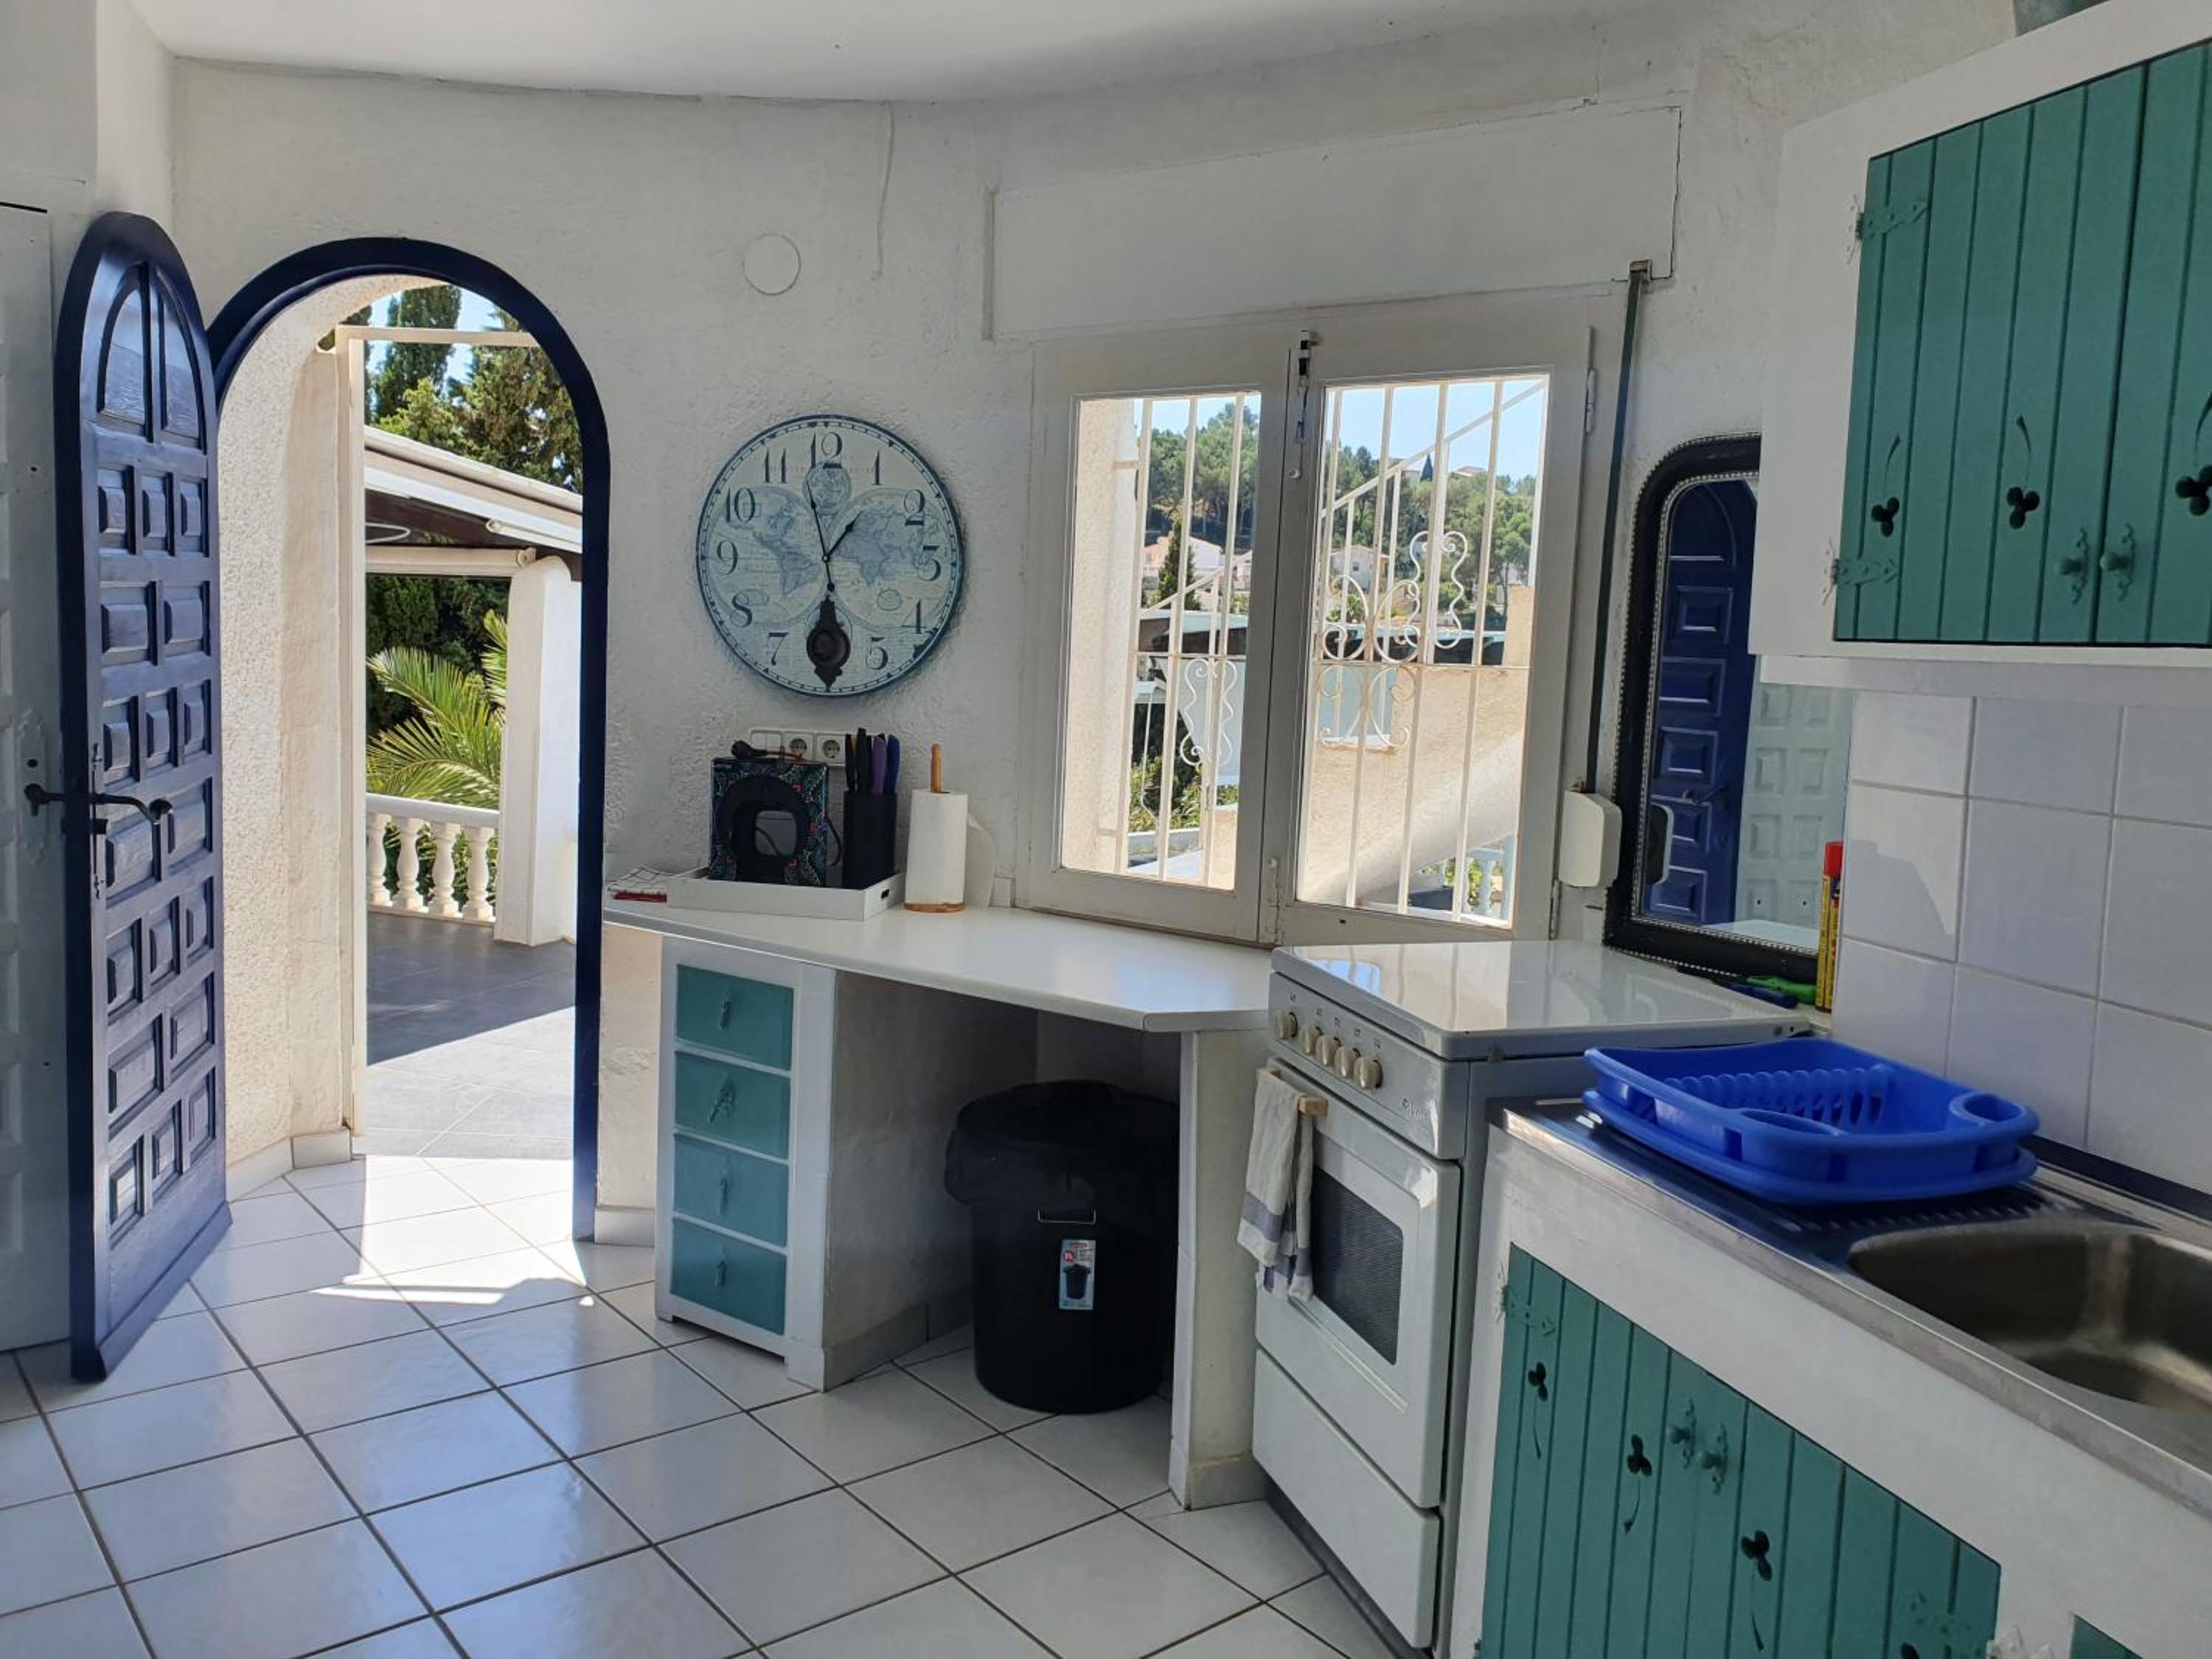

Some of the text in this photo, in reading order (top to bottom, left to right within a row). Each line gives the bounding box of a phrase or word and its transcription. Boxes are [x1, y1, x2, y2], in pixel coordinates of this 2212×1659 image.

[763, 448, 787, 484] 11
[810, 432, 843, 469] 12
[872, 449, 882, 485] 1
[725, 487, 755, 523] 10
[903, 490, 925, 526] 2
[716, 540, 737, 575] 9
[918, 545, 941, 581] 3
[730, 592, 752, 627] 8
[901, 600, 927, 634] 4
[768, 632, 788, 665] 7
[866, 636, 888, 669] 5
